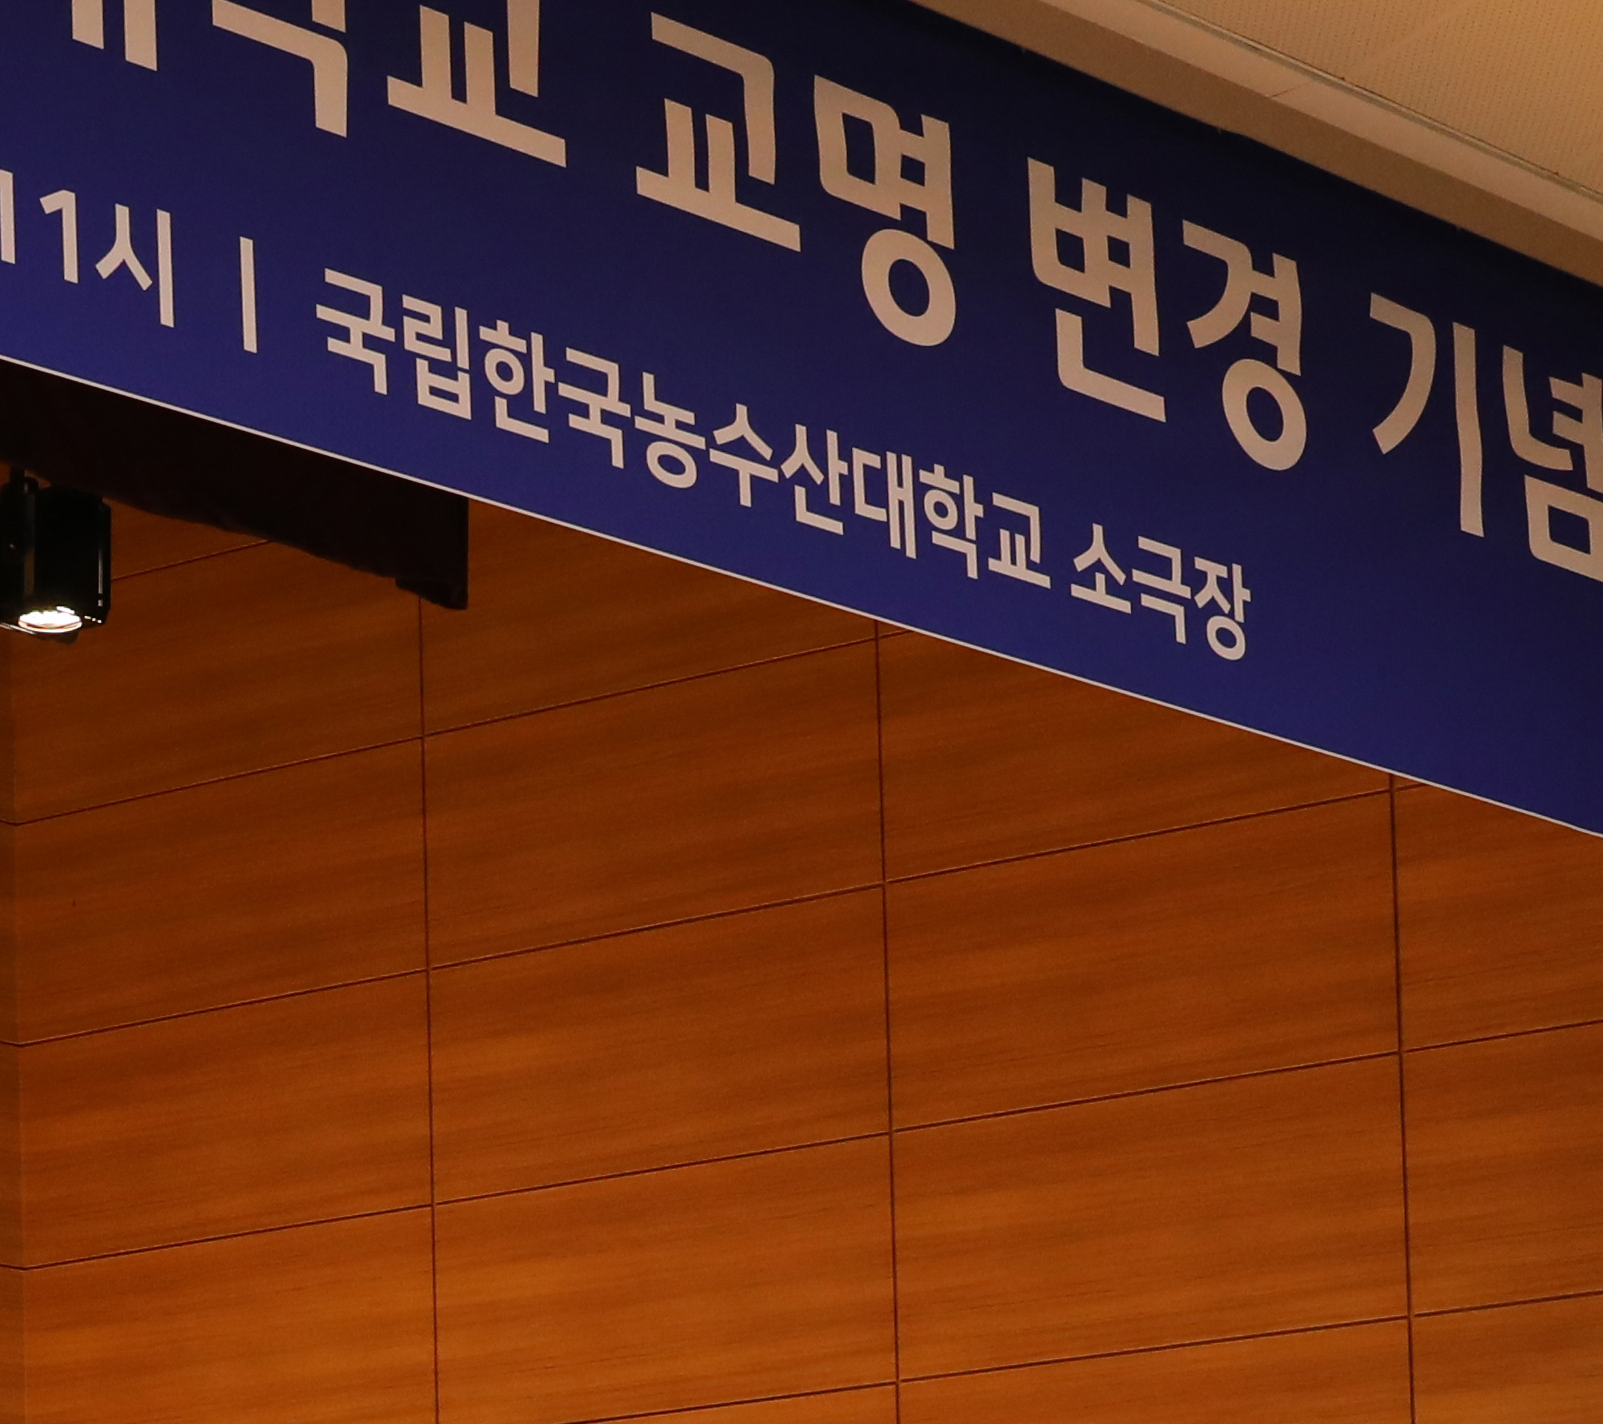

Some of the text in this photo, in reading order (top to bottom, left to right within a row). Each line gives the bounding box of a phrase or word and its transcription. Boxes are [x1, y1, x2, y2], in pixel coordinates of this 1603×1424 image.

[636, 13, 957, 347] 교명
[1027, 158, 1308, 471] 변경
[315, 267, 1051, 590] 국립한국농수산대학교
[1070, 523, 1251, 661] 소극장
